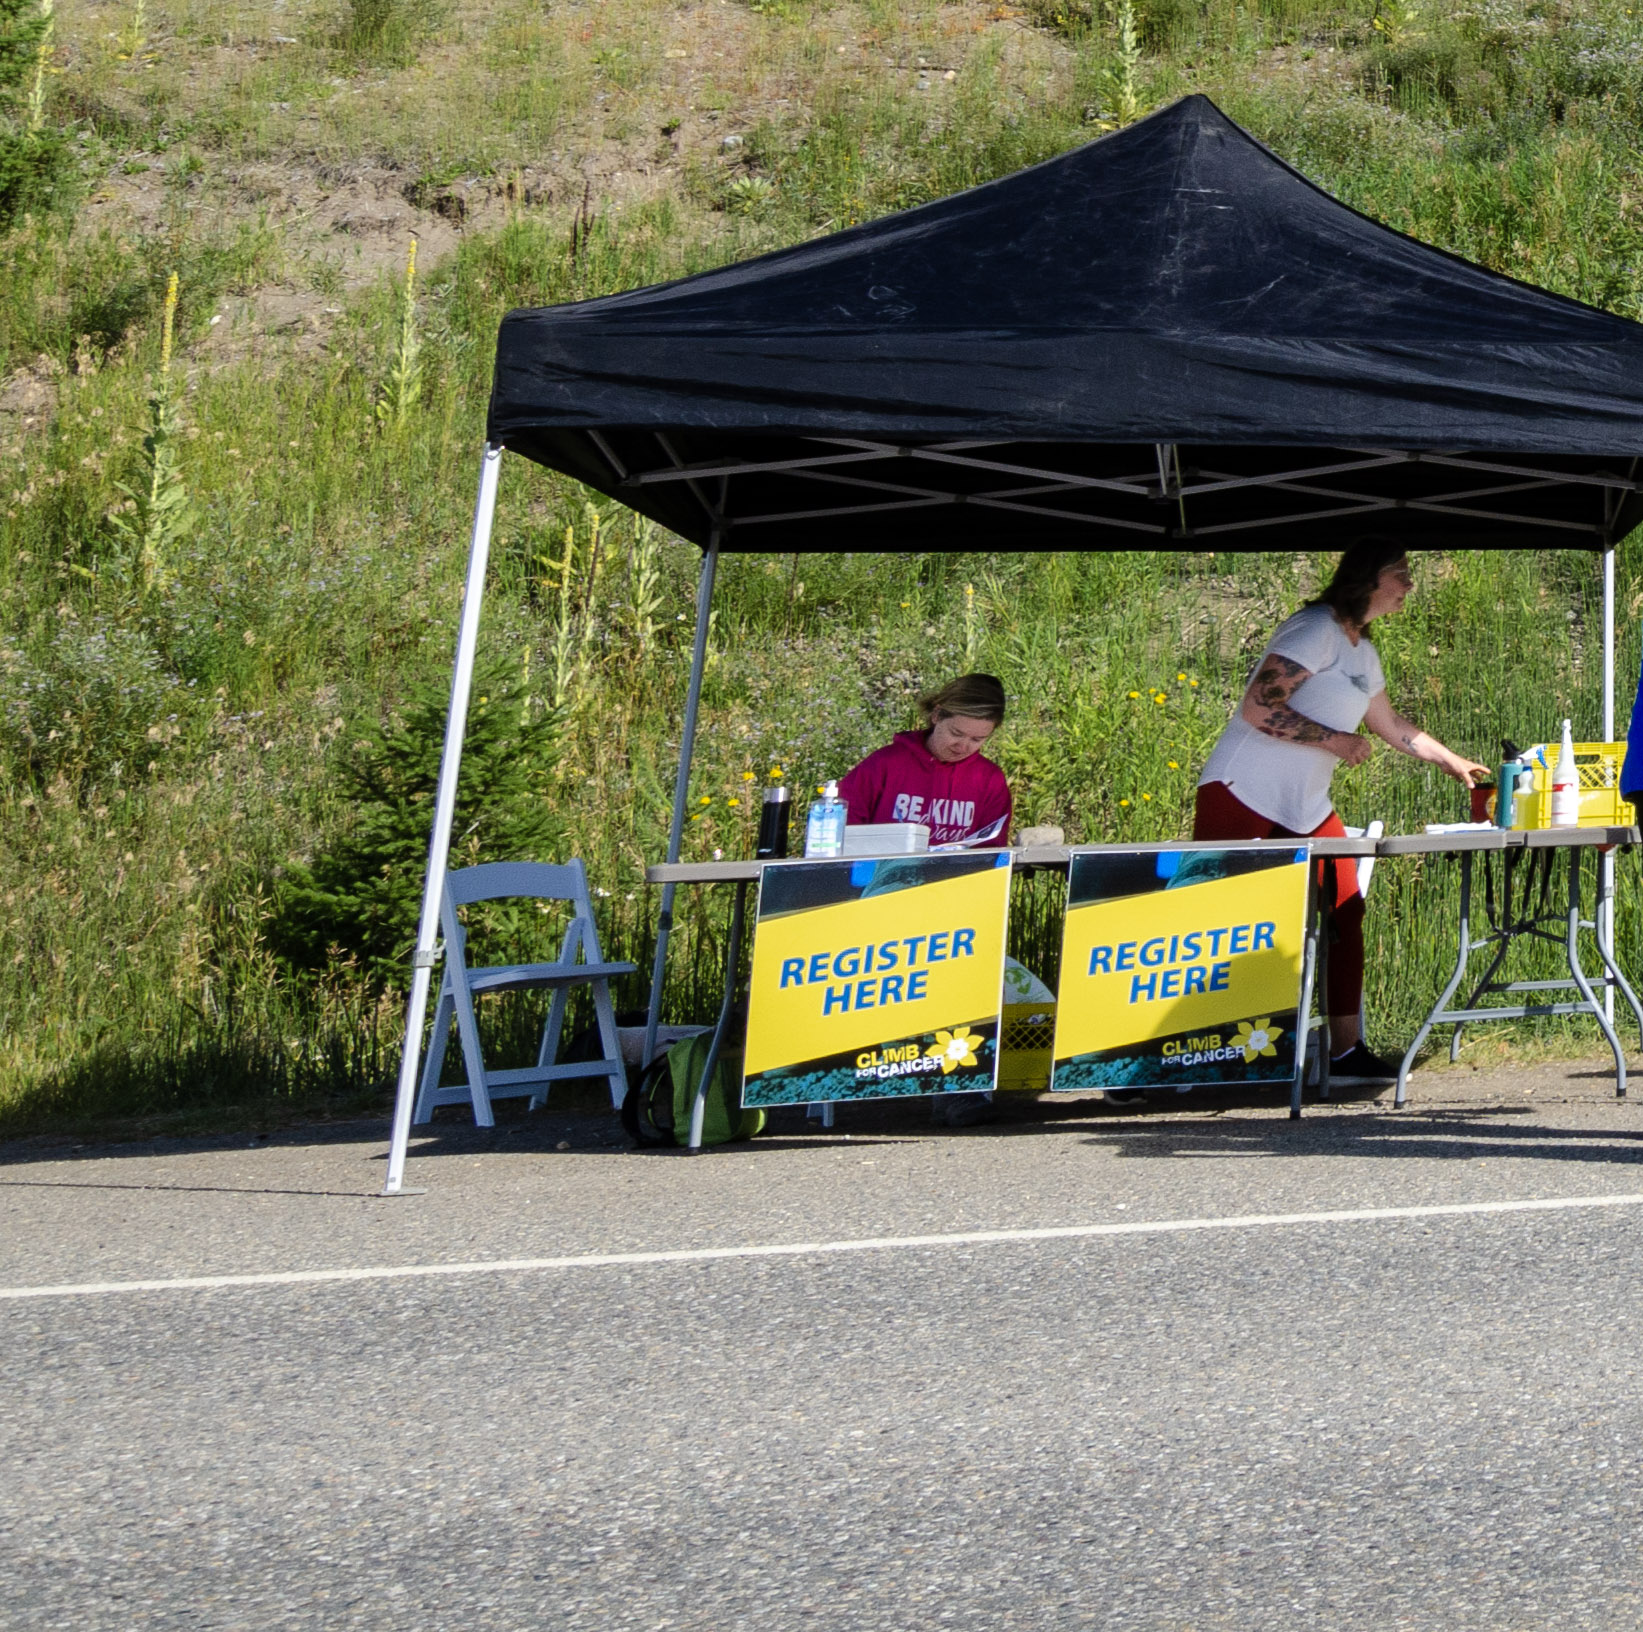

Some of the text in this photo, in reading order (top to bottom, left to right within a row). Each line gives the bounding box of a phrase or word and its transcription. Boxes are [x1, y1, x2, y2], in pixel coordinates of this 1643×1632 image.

[892, 793, 975, 827] BE KIND
[780, 928, 976, 989] REGISTER
[1088, 921, 1276, 976] REGISTER
[822, 970, 929, 1016] HERE
[1129, 961, 1231, 1004] HERE
[856, 1044, 920, 1068] CLIMB
[1162, 1034, 1222, 1056] CLIMB
[1162, 1045, 1246, 1066] FOR CANCER
[855, 1055, 945, 1079] FOR CANCER
